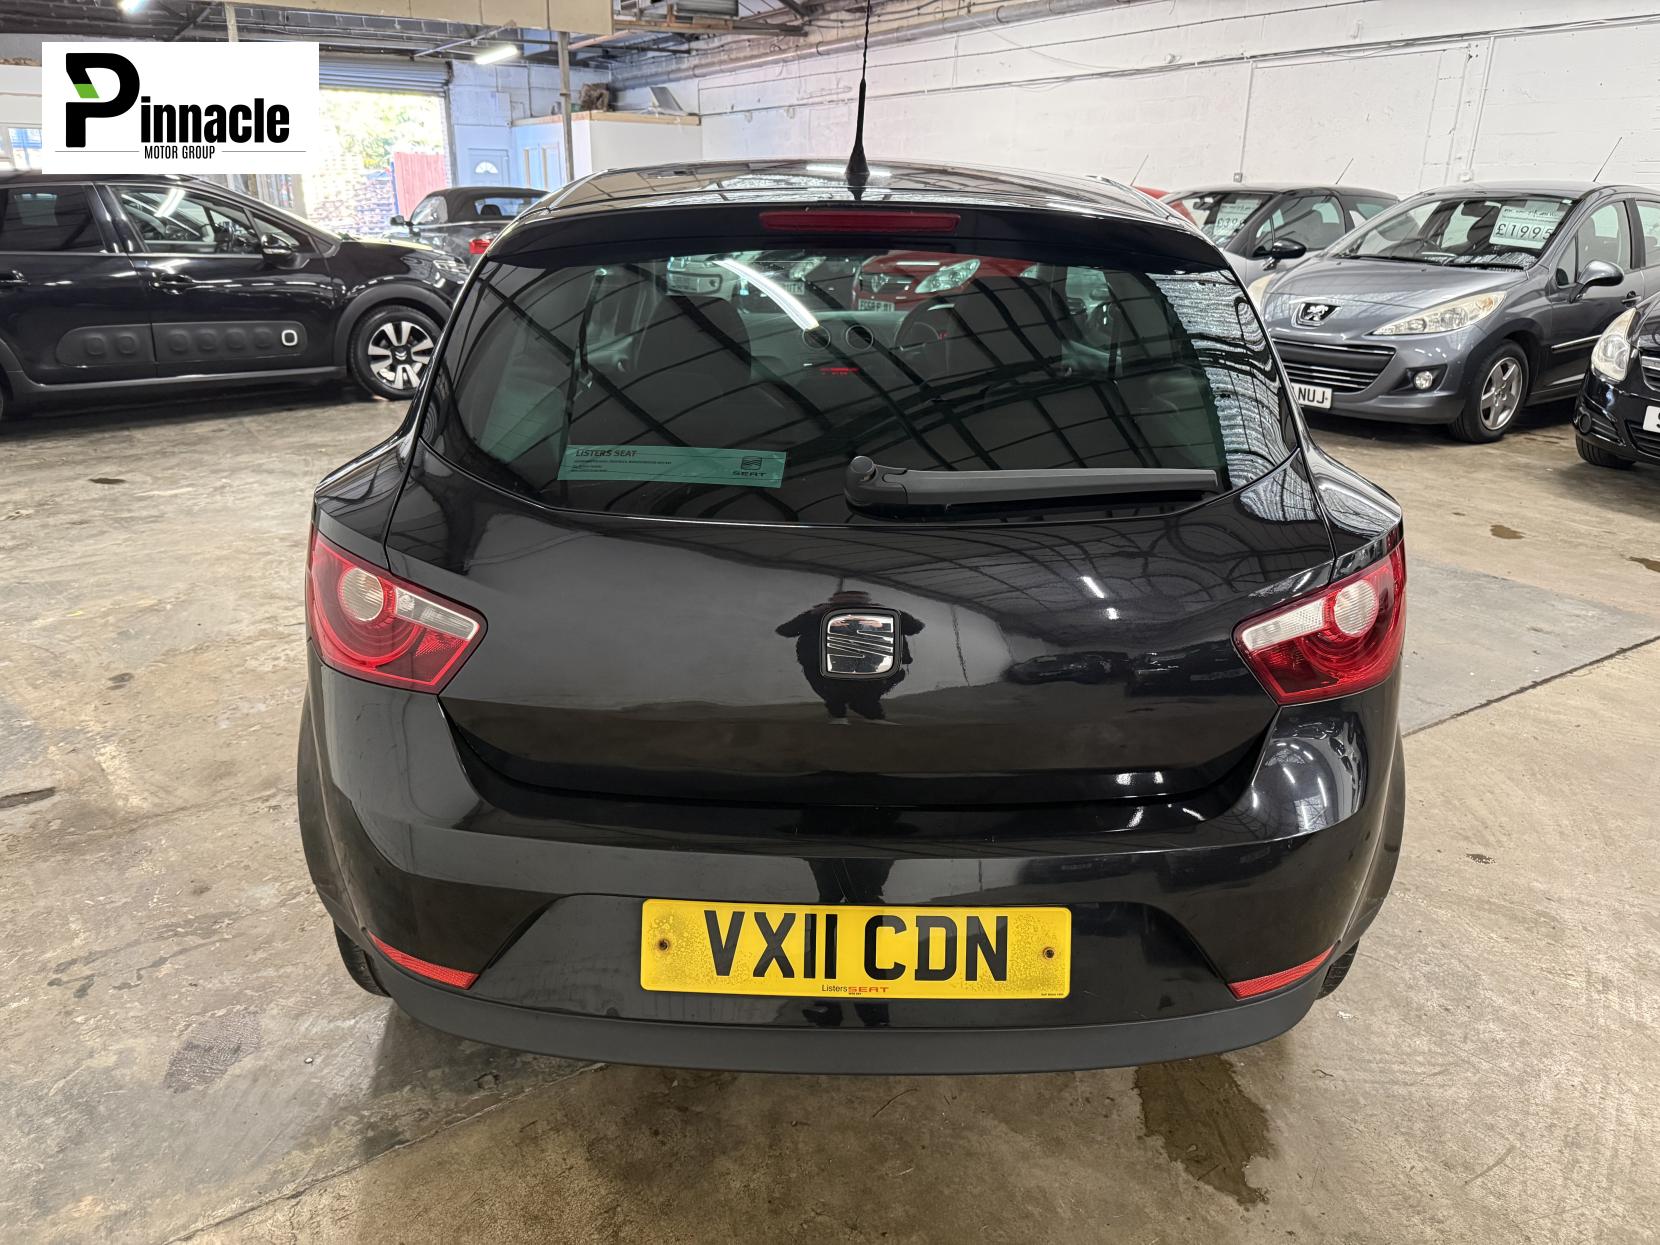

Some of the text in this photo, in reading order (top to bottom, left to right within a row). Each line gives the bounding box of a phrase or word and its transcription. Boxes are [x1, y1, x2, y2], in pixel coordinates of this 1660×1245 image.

[1495, 223, 1555, 240] £1995
[576, 449, 612, 457] LISTERS
[703, 909, 1009, 982] VX11 CDN
[821, 984, 848, 992] Listers
